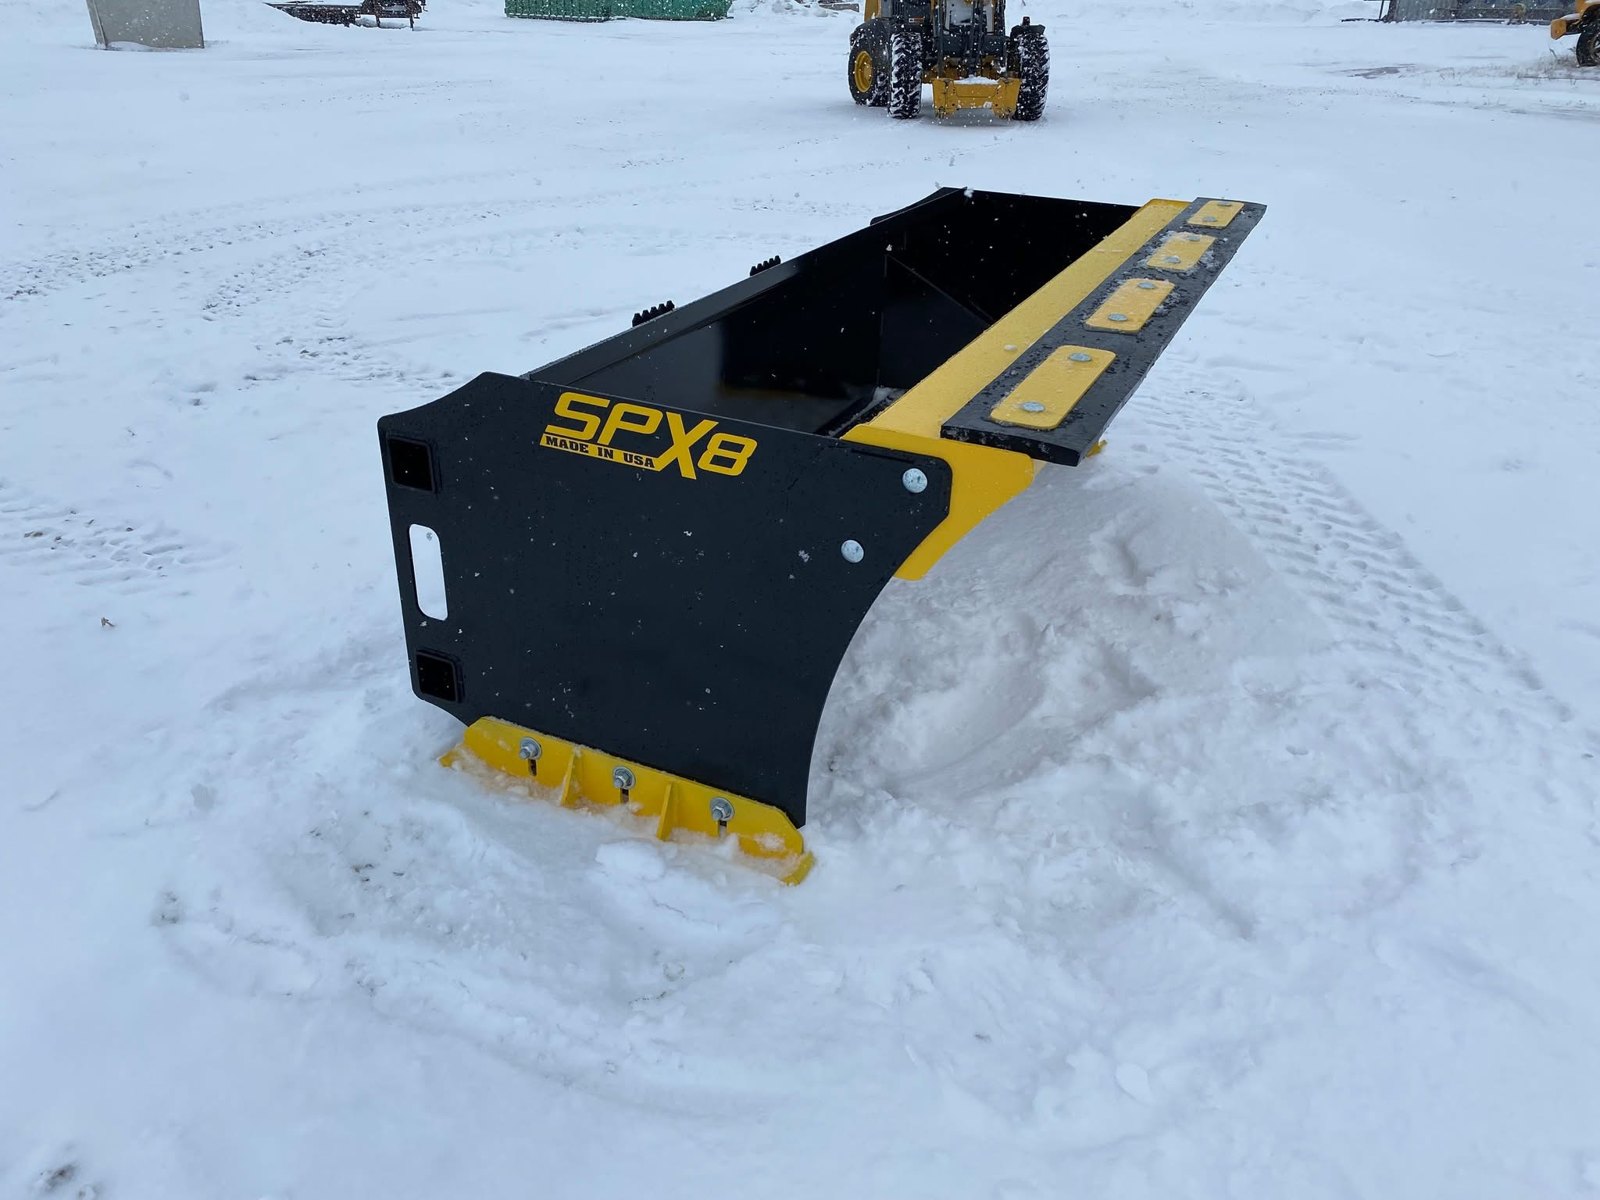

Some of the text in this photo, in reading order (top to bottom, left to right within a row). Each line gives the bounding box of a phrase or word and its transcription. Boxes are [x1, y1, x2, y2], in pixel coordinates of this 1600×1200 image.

[543, 391, 758, 480] SPX8
[545, 435, 655, 469] MADE IN USA
